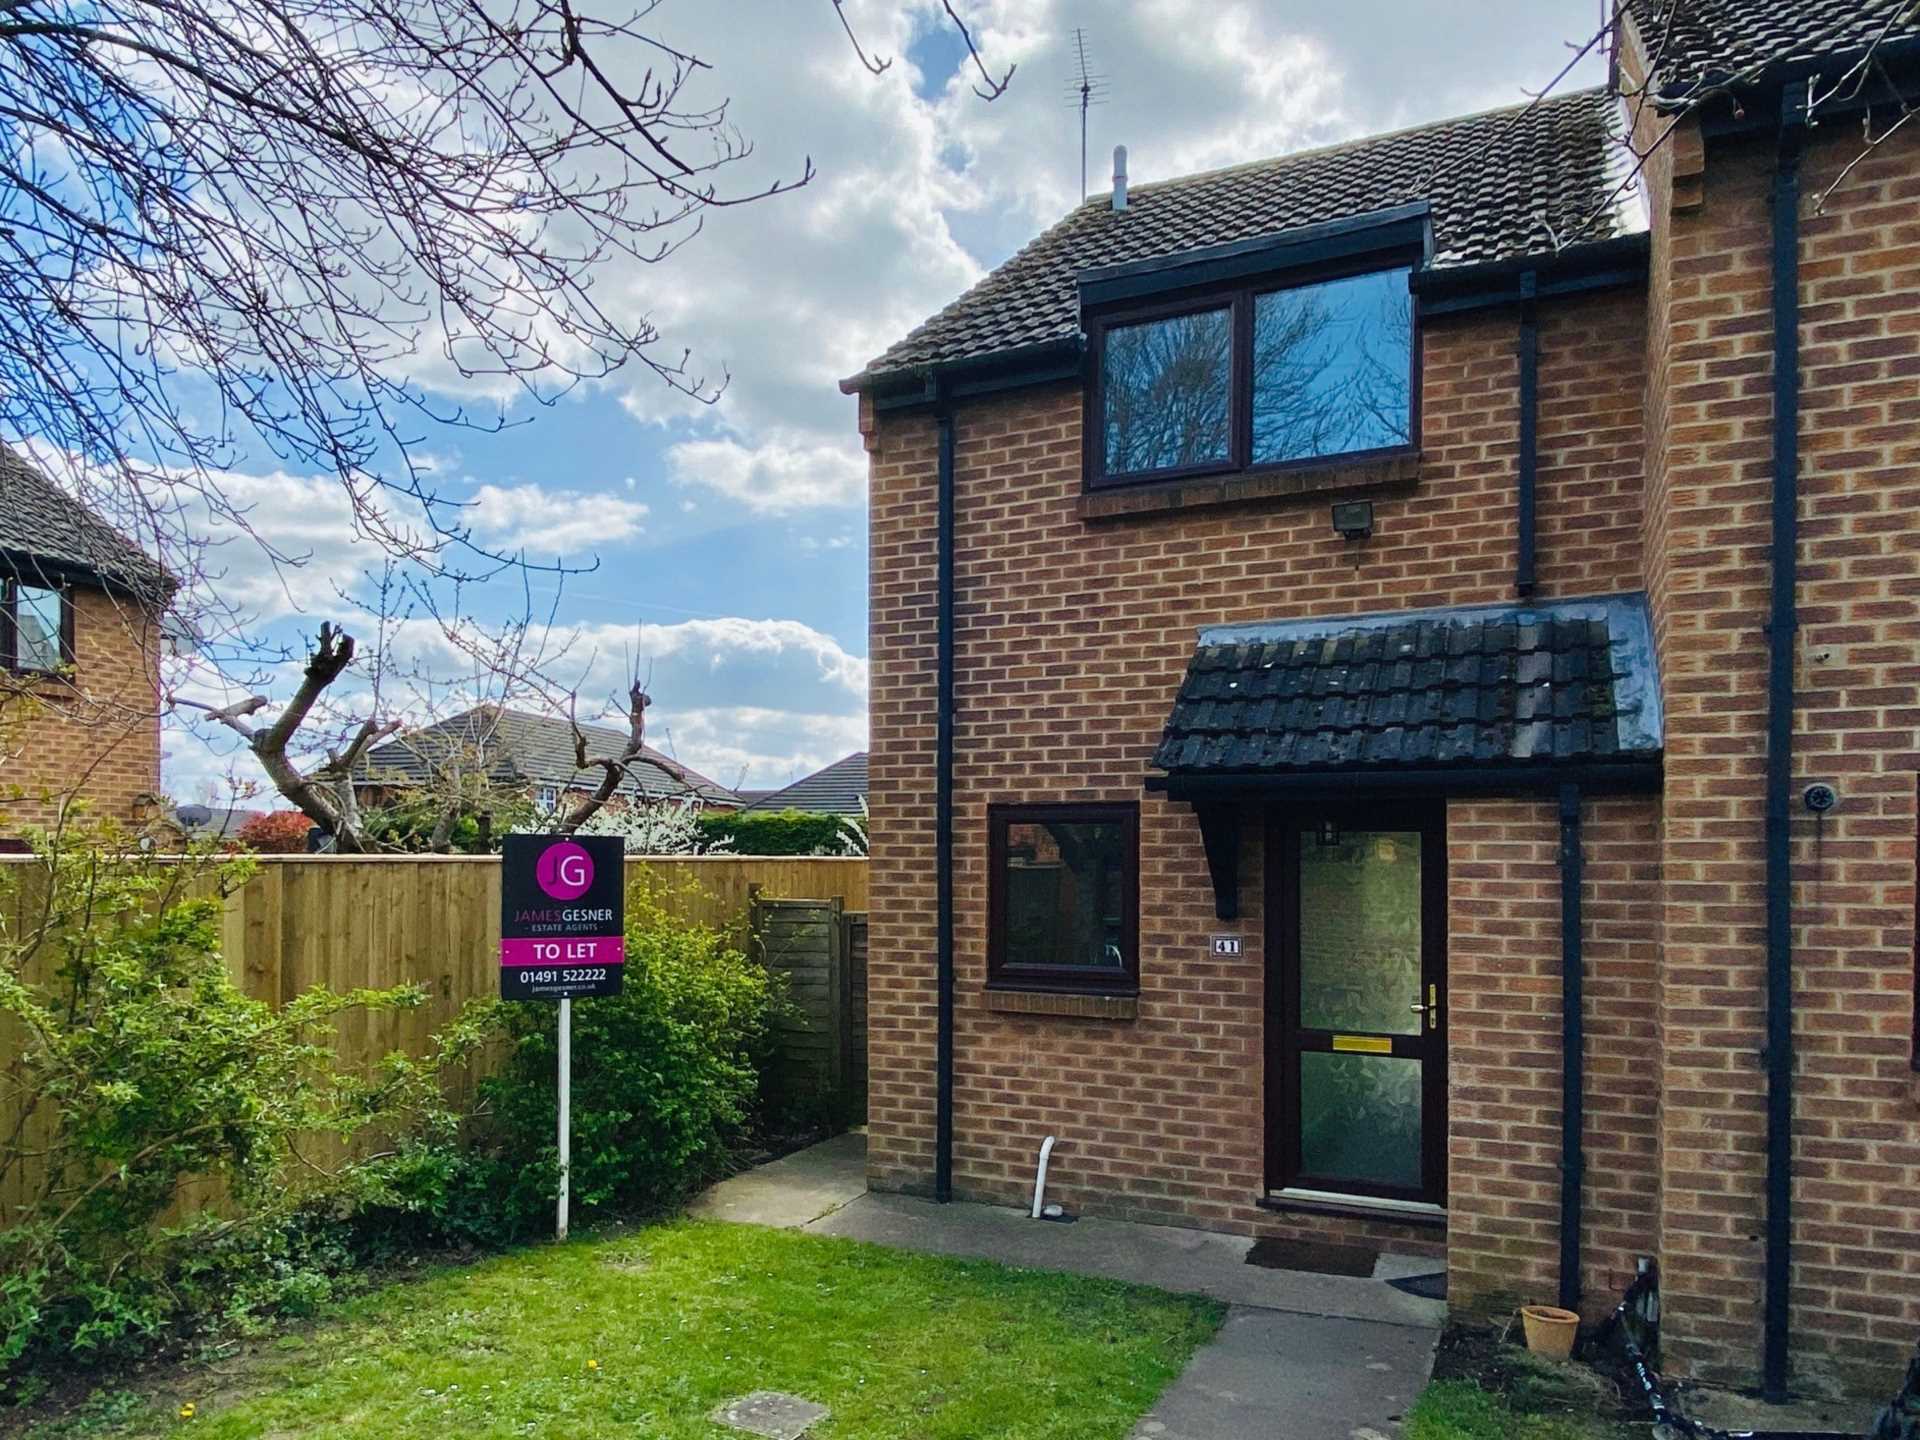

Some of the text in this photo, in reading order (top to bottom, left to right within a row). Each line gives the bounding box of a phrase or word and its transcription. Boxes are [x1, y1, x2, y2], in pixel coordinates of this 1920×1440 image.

[532, 923, 598, 932] ESTATE AGENTS
[533, 944, 597, 960] TO LET
[1218, 940, 1234, 952] 41
[520, 968, 606, 983] 01491 522222
